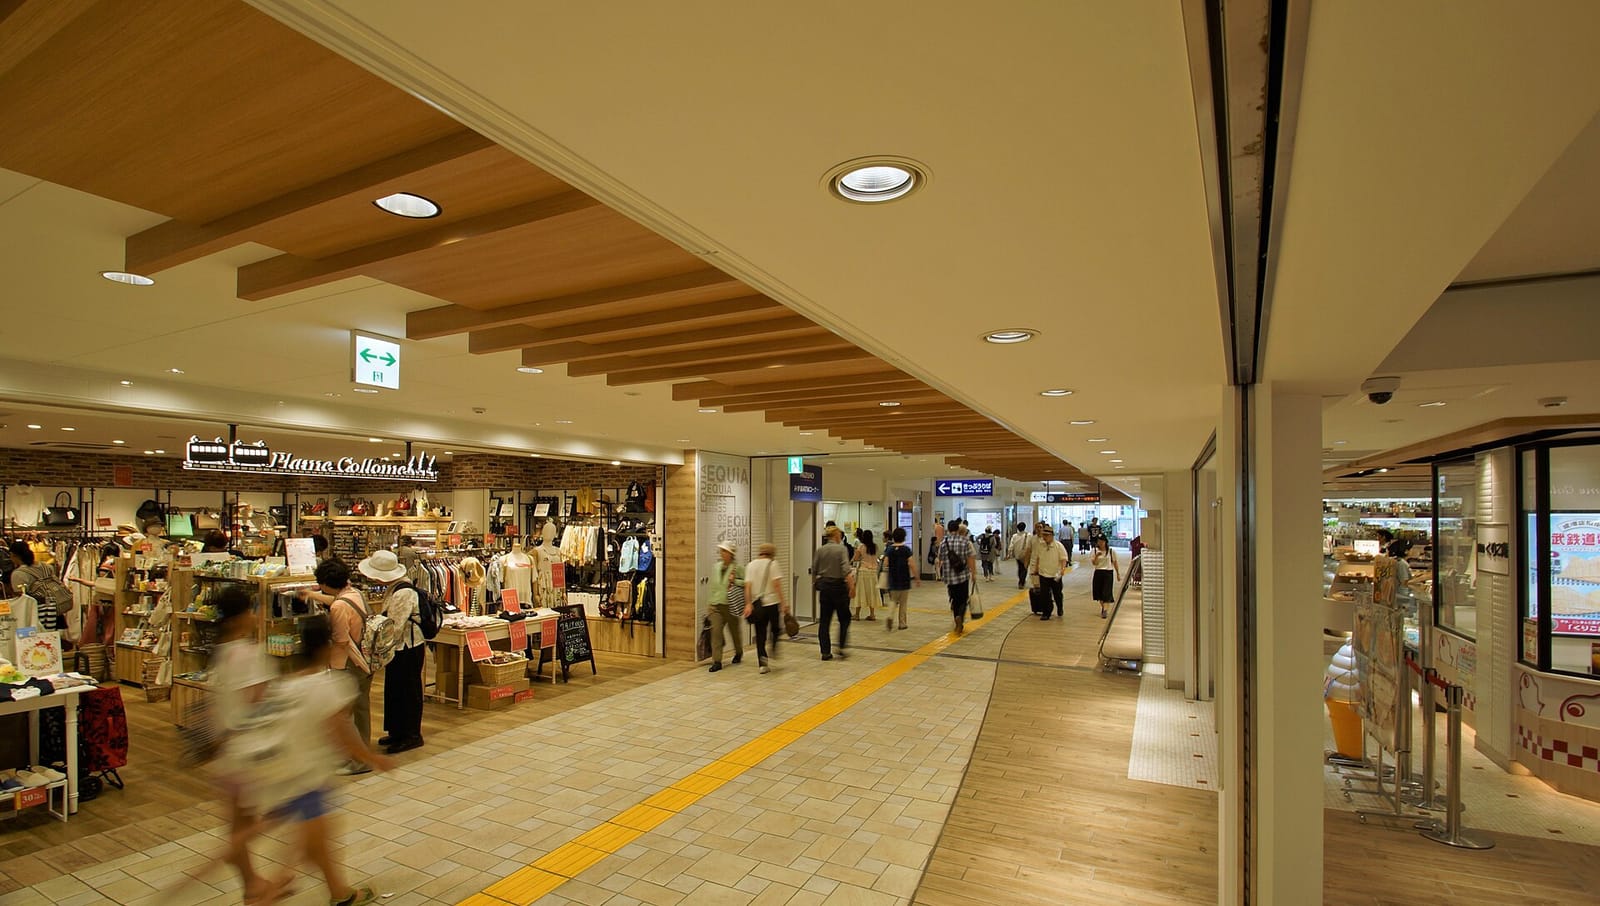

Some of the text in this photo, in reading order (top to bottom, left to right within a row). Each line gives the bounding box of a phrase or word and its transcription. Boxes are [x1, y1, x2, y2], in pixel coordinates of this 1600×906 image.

[266, 451, 334, 472] Plame
[1552, 533, 1600, 545] 武鉄道
